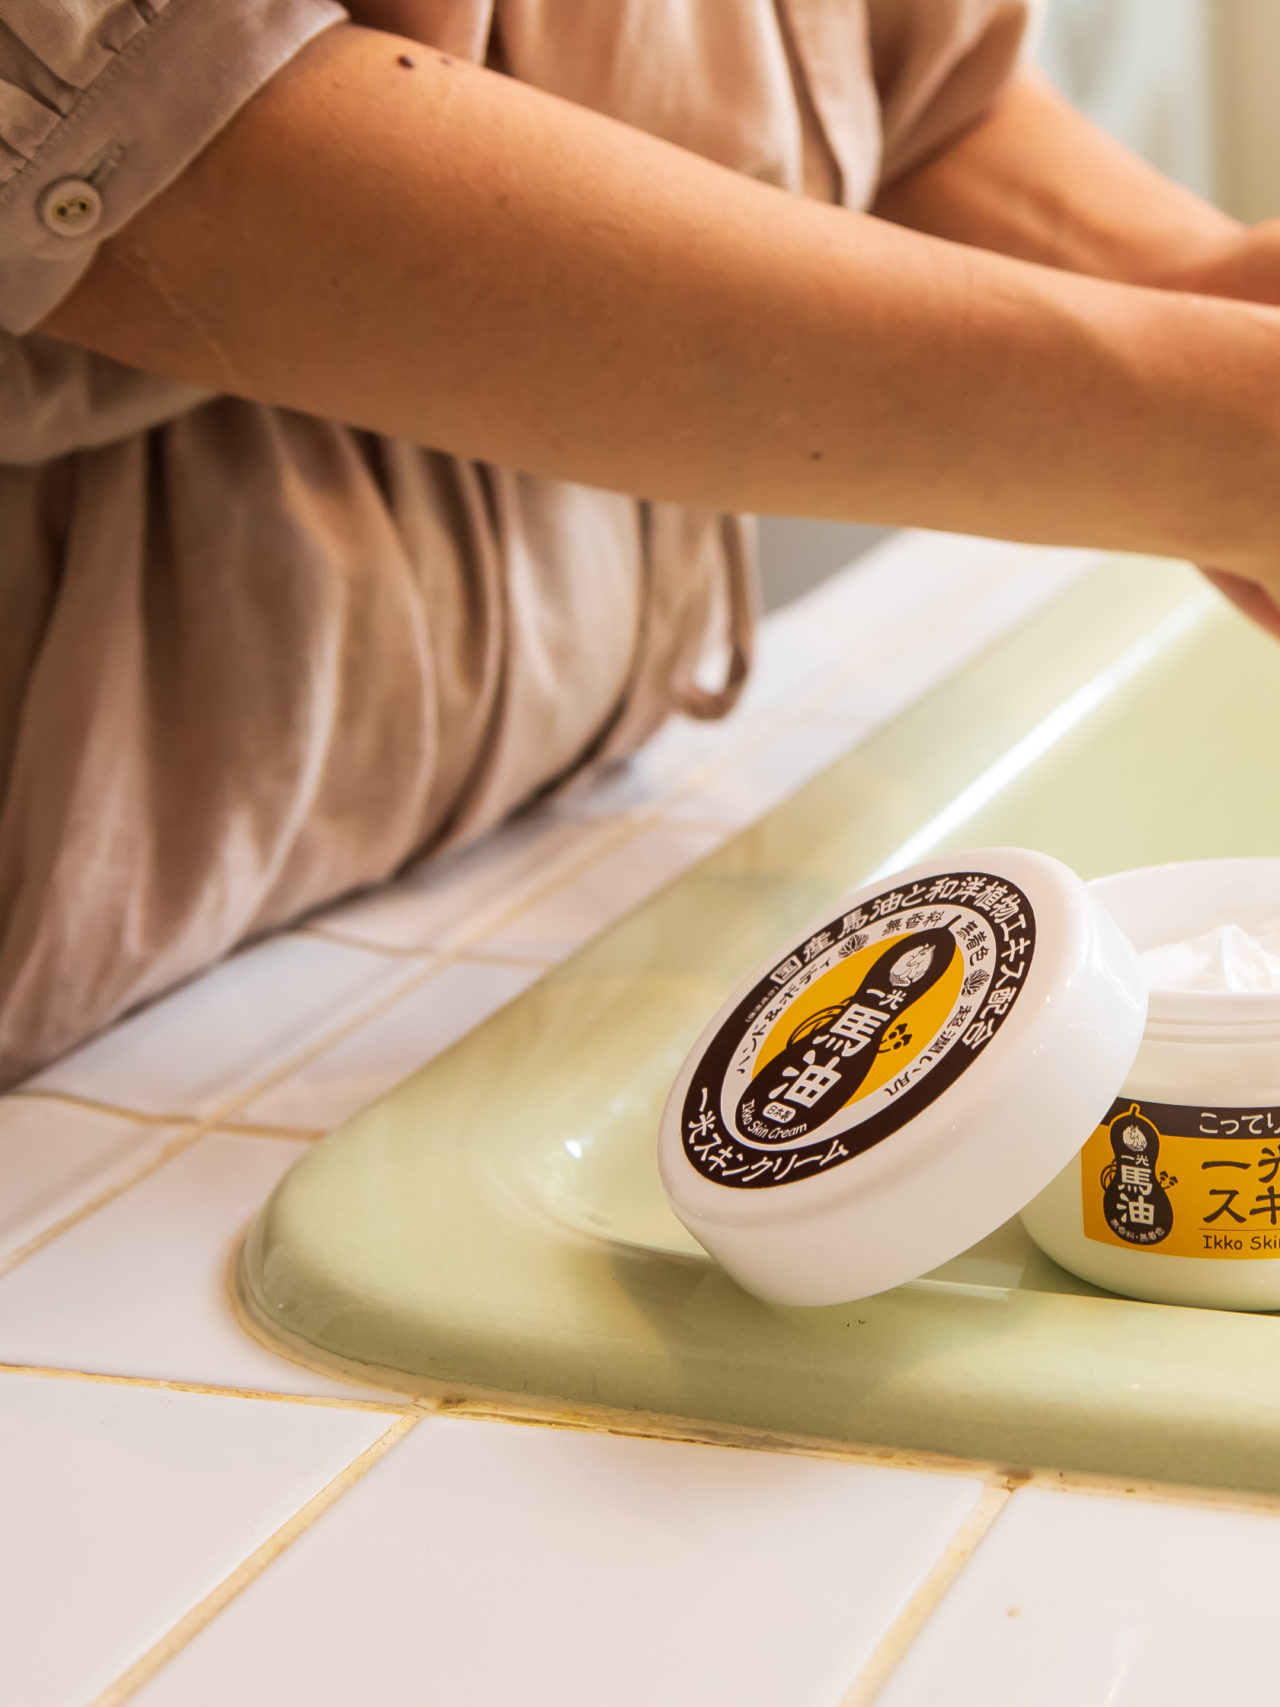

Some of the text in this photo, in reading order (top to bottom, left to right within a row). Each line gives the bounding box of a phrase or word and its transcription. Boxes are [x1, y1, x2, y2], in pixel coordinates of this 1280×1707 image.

[882, 910, 945, 937] 無香料
[956, 919, 990, 967] 無着色
[770, 877, 1031, 1050] 国産馬油と和洋植物エキス配合
[768, 1003, 891, 1108] 馬油
[688, 1087, 849, 1183] 一光スキンクリーム
[747, 1120, 769, 1139] Skin
[768, 1122, 808, 1140] Cream
[1116, 1164, 1153, 1226] 馬油
[1203, 1234, 1243, 1251] Ikko
